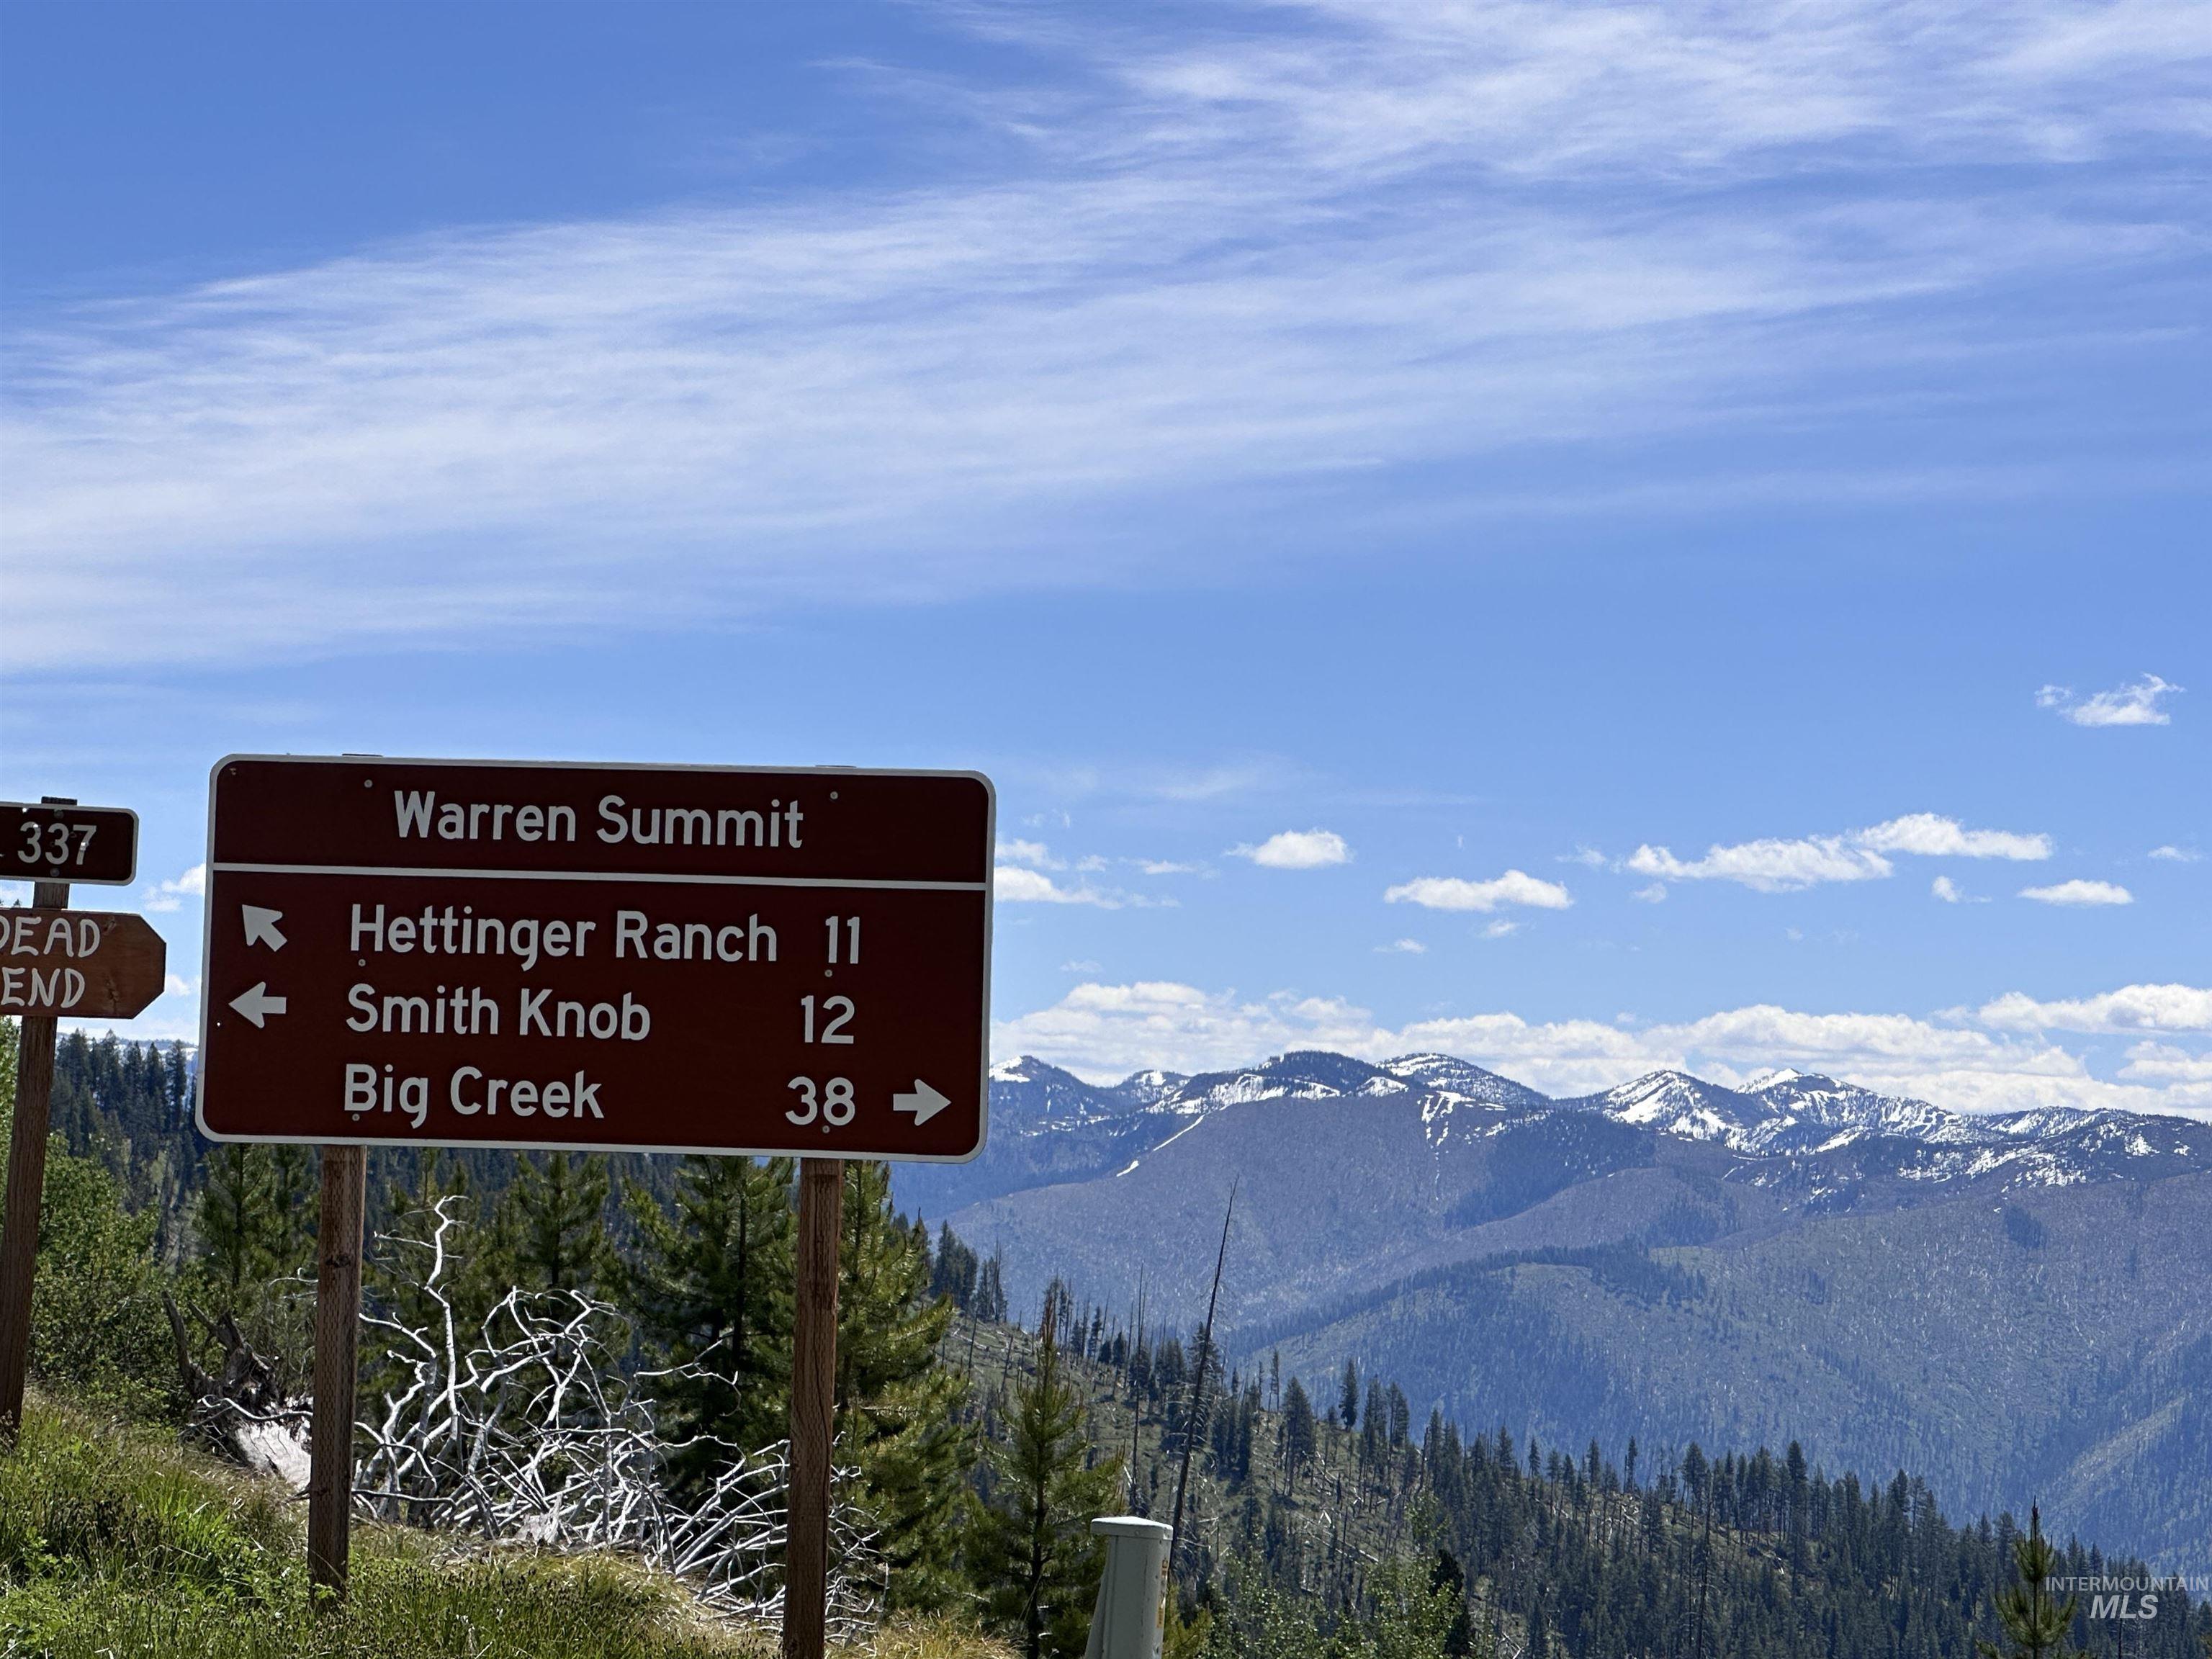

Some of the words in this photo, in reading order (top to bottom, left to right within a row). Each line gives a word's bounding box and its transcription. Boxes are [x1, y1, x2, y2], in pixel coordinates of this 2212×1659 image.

[18, 822, 97, 865] 337
[394, 790, 576, 842] Warren
[596, 795, 804, 848] Summit
[351, 904, 596, 971] Hettinger
[616, 910, 777, 962] Ranch
[825, 915, 860, 964] 11
[1, 966, 86, 1008] END
[346, 983, 499, 1035] Smith
[519, 988, 650, 1041] Knob
[801, 995, 855, 1044] 12
[344, 1064, 428, 1129] Big
[450, 1066, 605, 1119] Creek
[785, 1076, 855, 1126] 38
